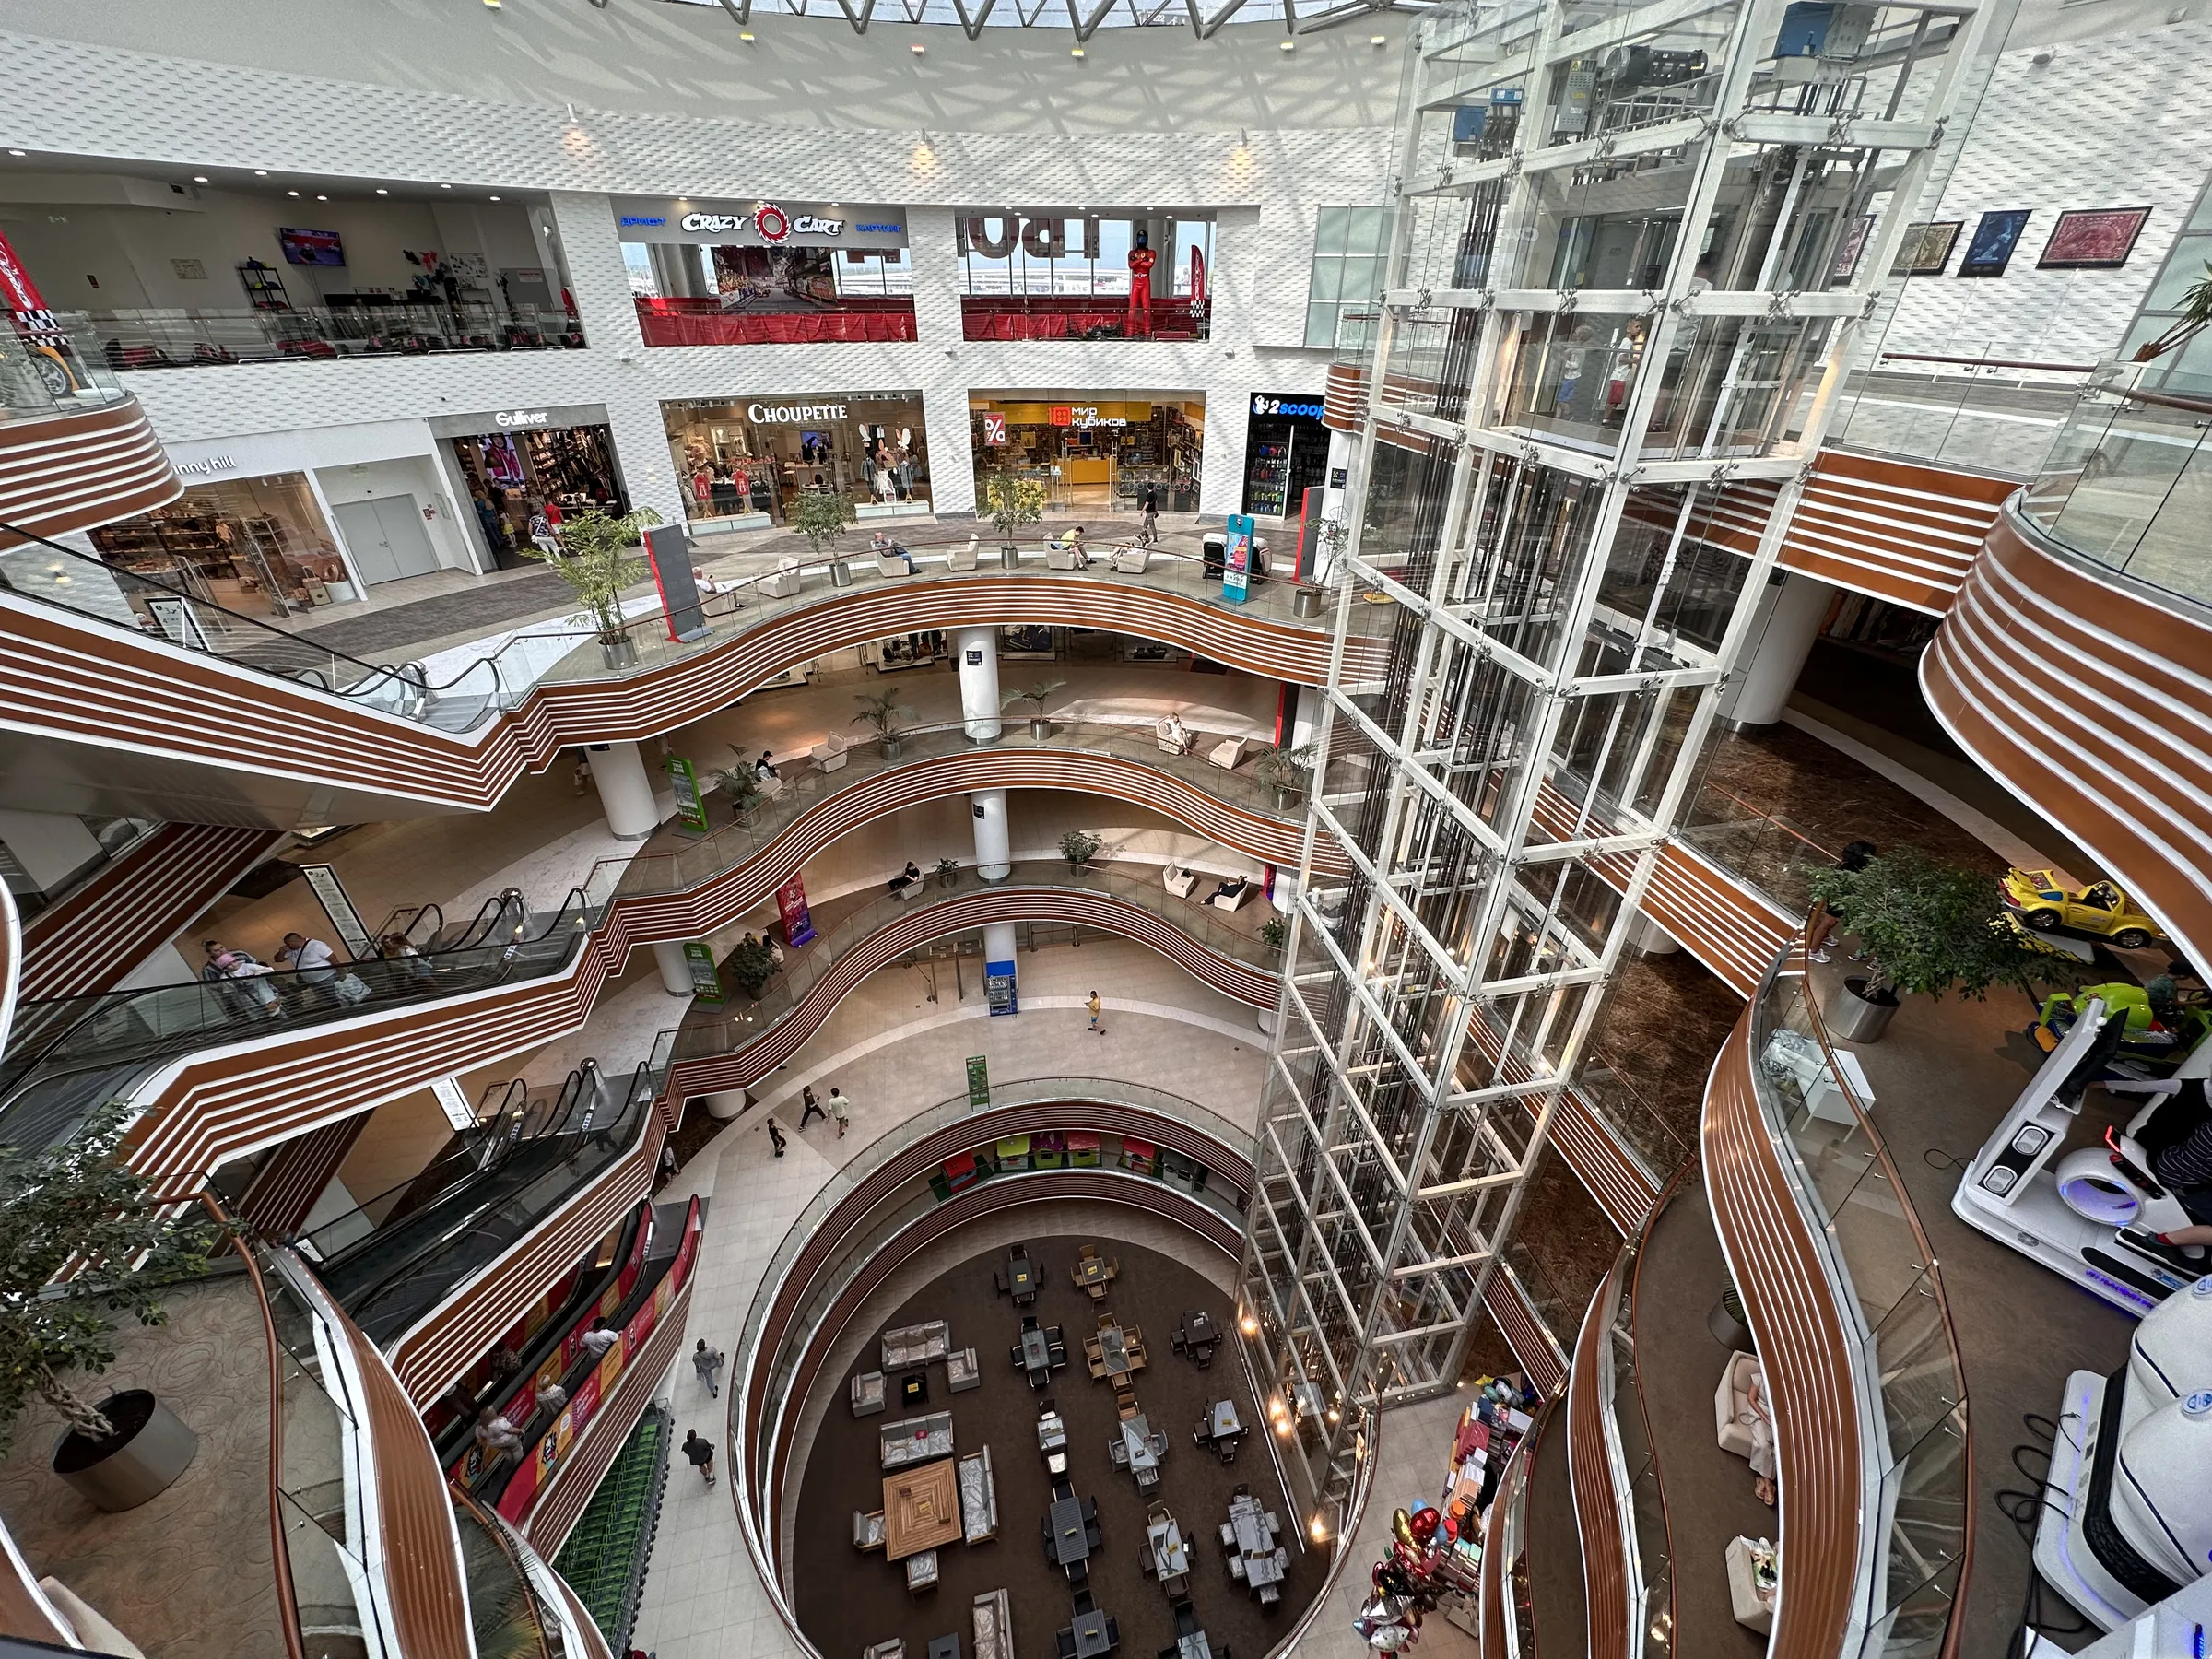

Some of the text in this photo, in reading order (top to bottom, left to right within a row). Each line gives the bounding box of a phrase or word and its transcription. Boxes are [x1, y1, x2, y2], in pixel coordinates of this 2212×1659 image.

[621, 216, 666, 227] ДРИФТ
[681, 212, 845, 236] CRAZY CART
[855, 223, 901, 233] КАРТИНГ
[495, 410, 548, 427] Gulliver
[747, 403, 848, 424] CHOUPETTE
[209, 455, 237, 470] hill
